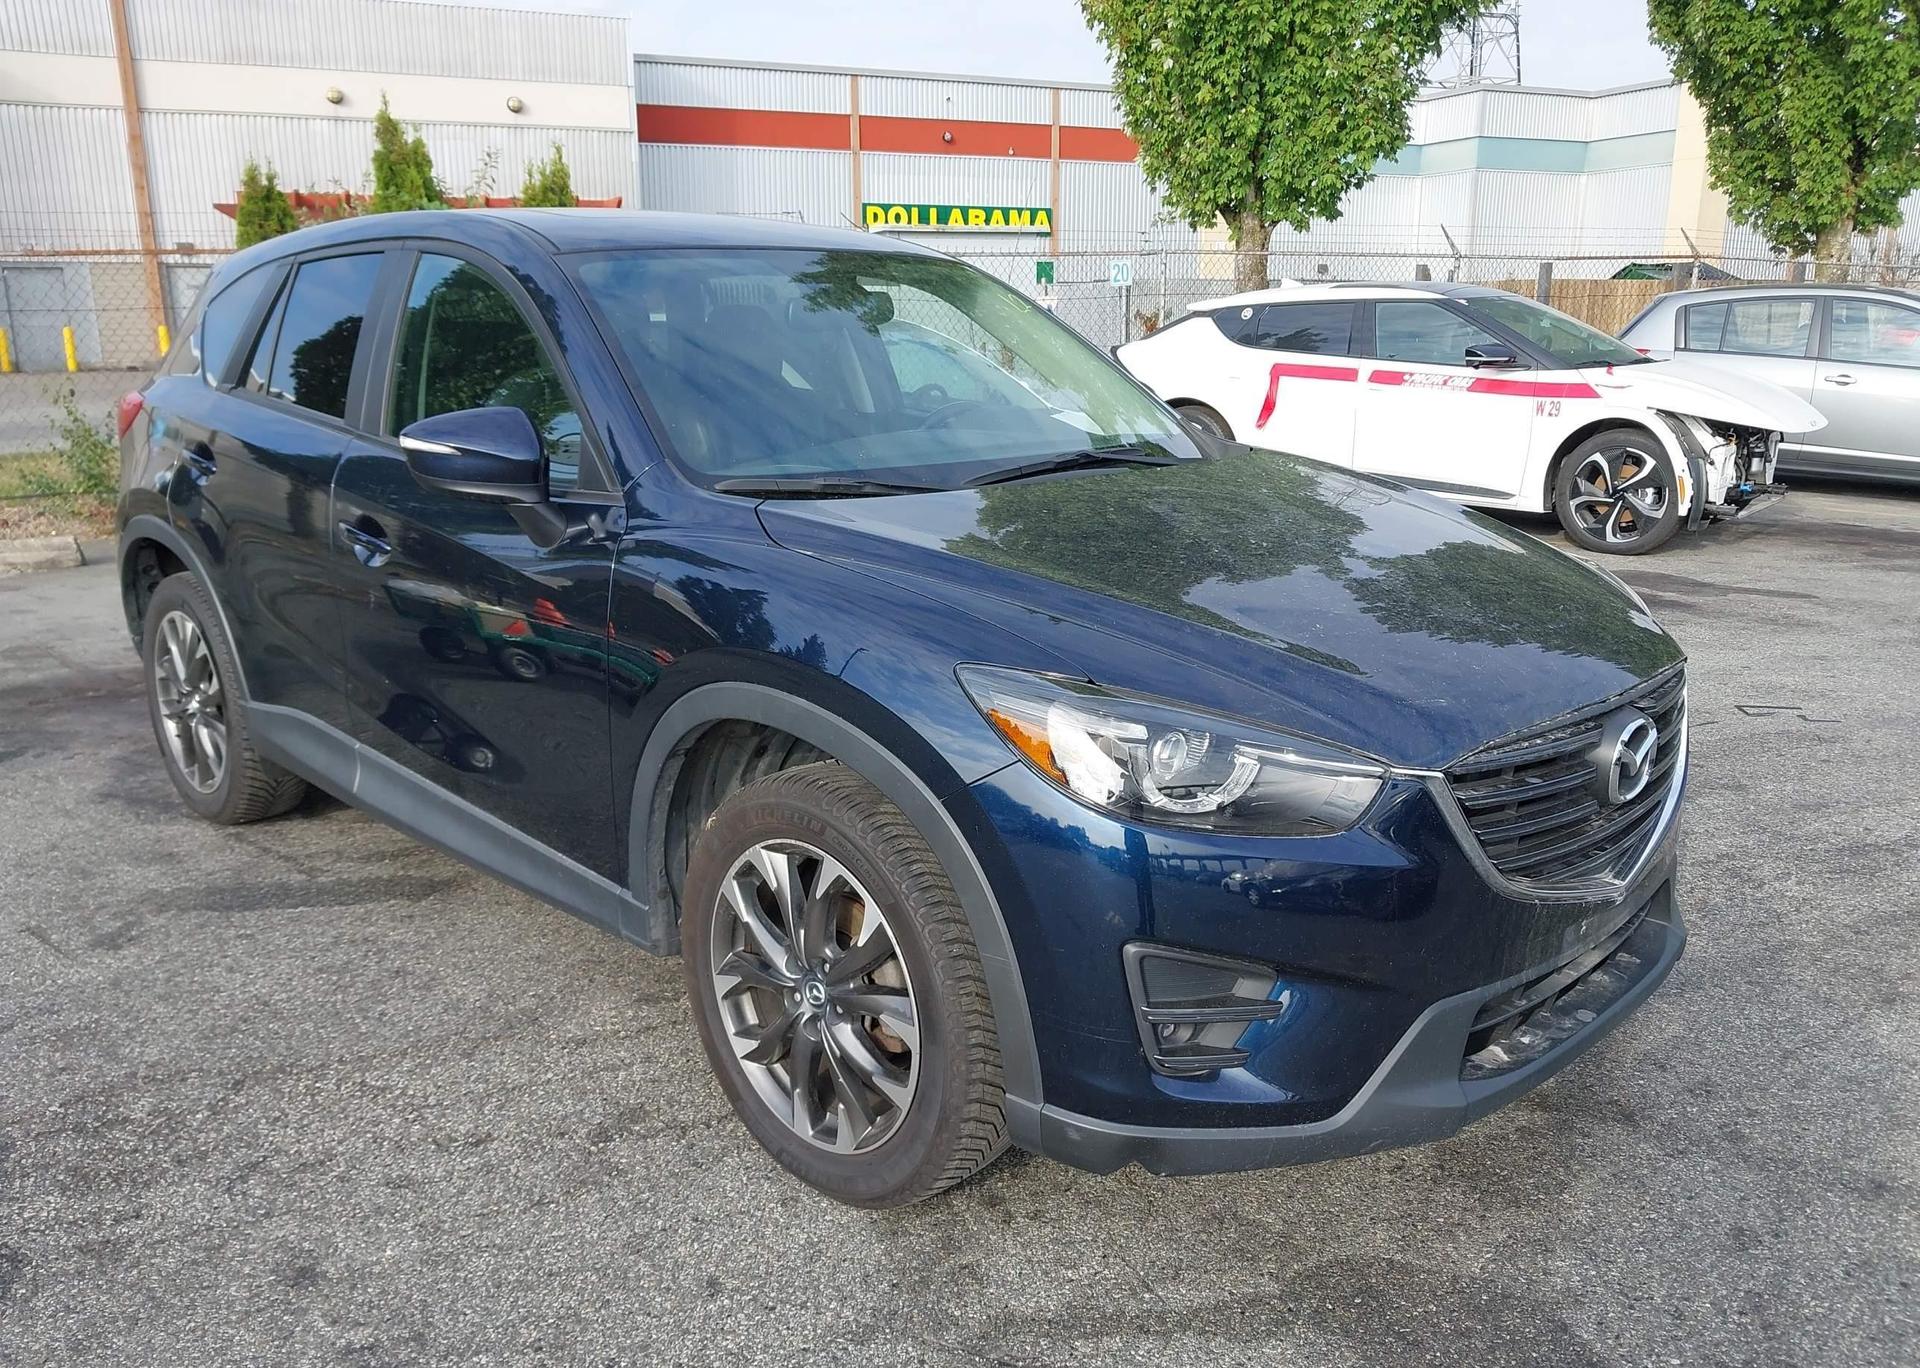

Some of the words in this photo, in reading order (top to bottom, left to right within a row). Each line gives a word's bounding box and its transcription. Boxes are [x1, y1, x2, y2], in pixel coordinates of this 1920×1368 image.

[865, 205, 1051, 230] DOLLARAMA
[1112, 262, 1129, 283] 20
[1536, 399, 1547, 416] W
[1548, 400, 1561, 417] 29
